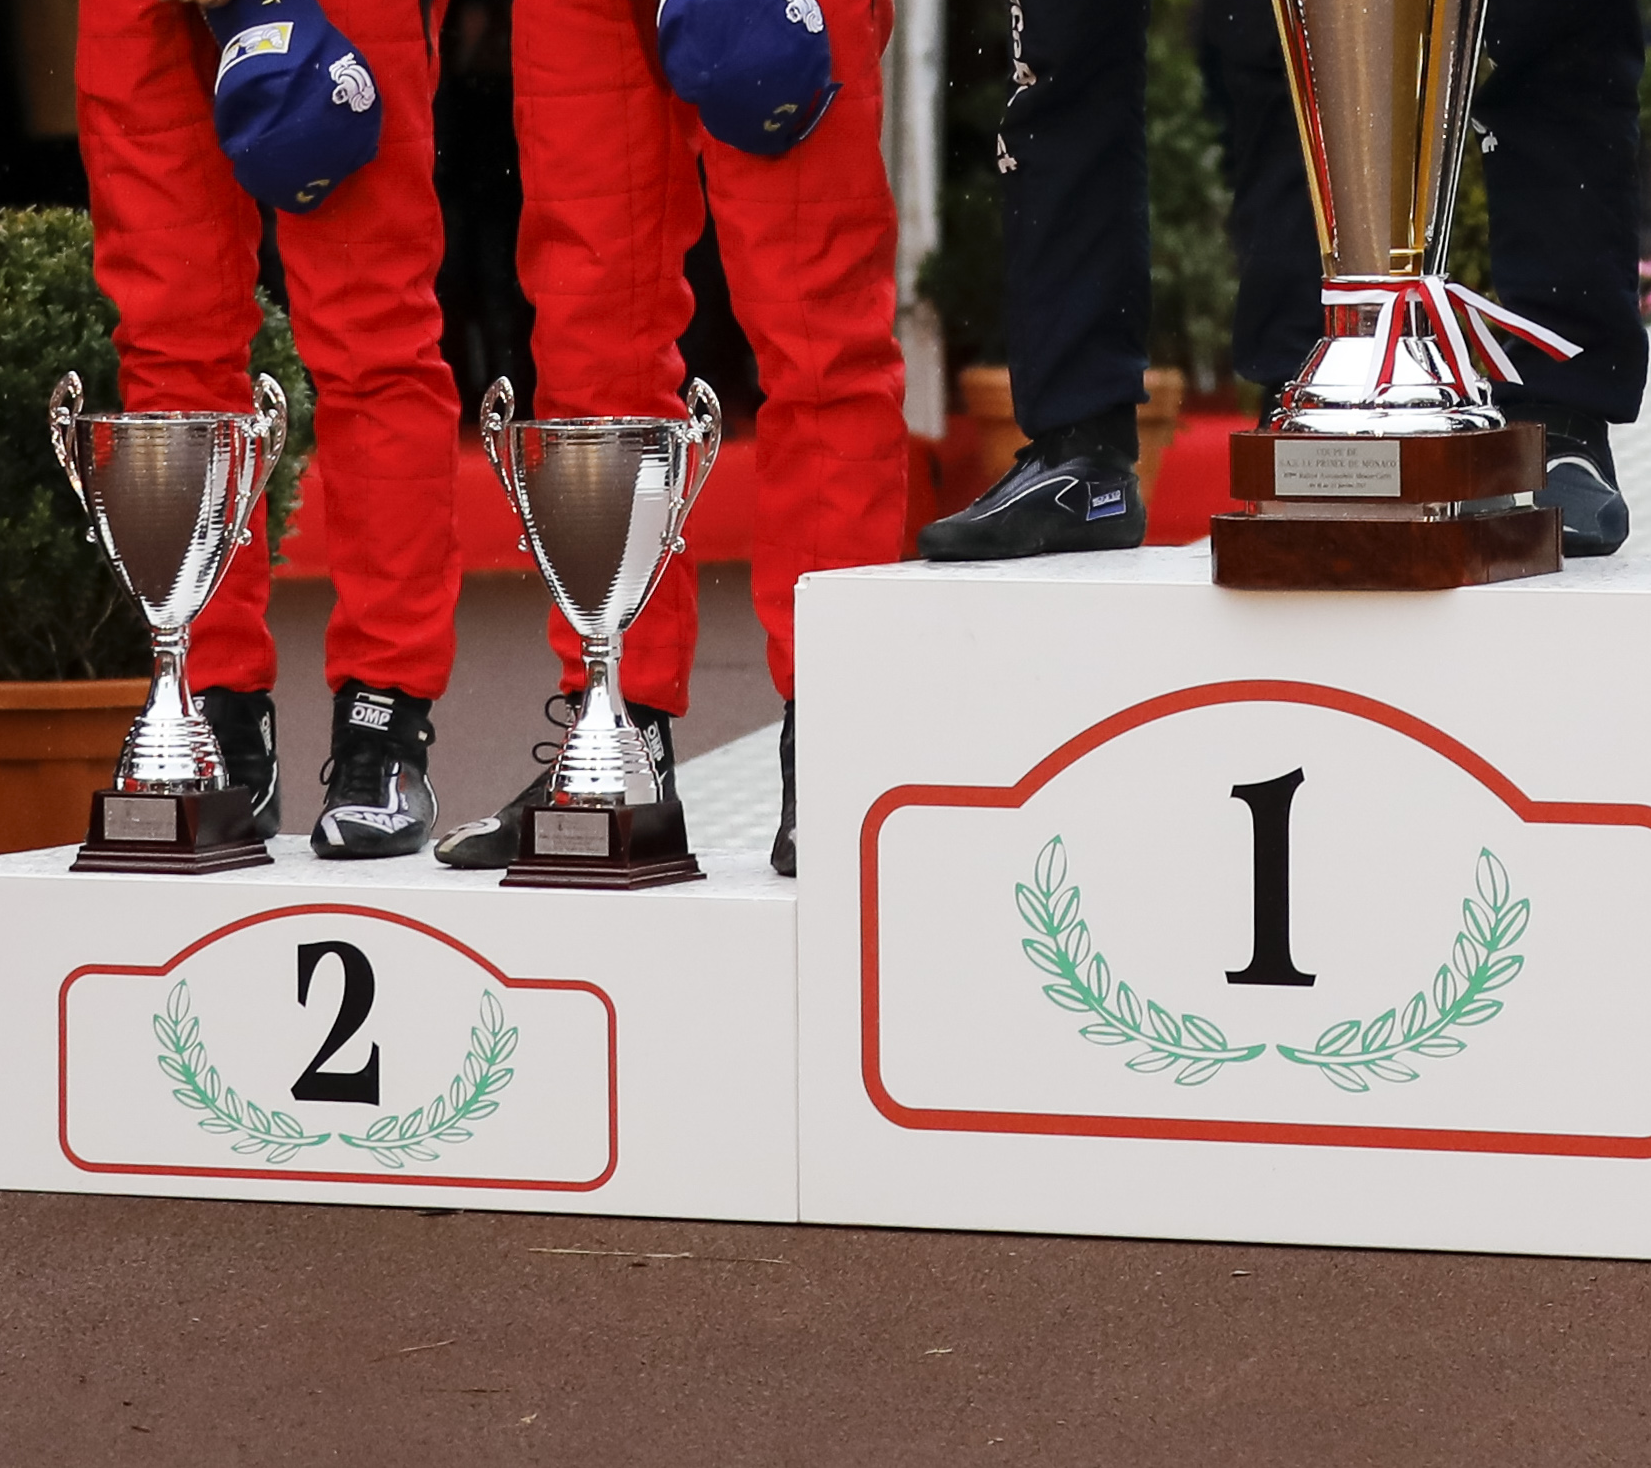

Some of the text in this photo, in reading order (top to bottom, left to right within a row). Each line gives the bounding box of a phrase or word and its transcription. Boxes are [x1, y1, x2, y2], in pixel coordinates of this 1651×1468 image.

[351, 704, 391, 728] OMP
[1224, 766, 1318, 988] 1
[291, 939, 381, 1107] 2
